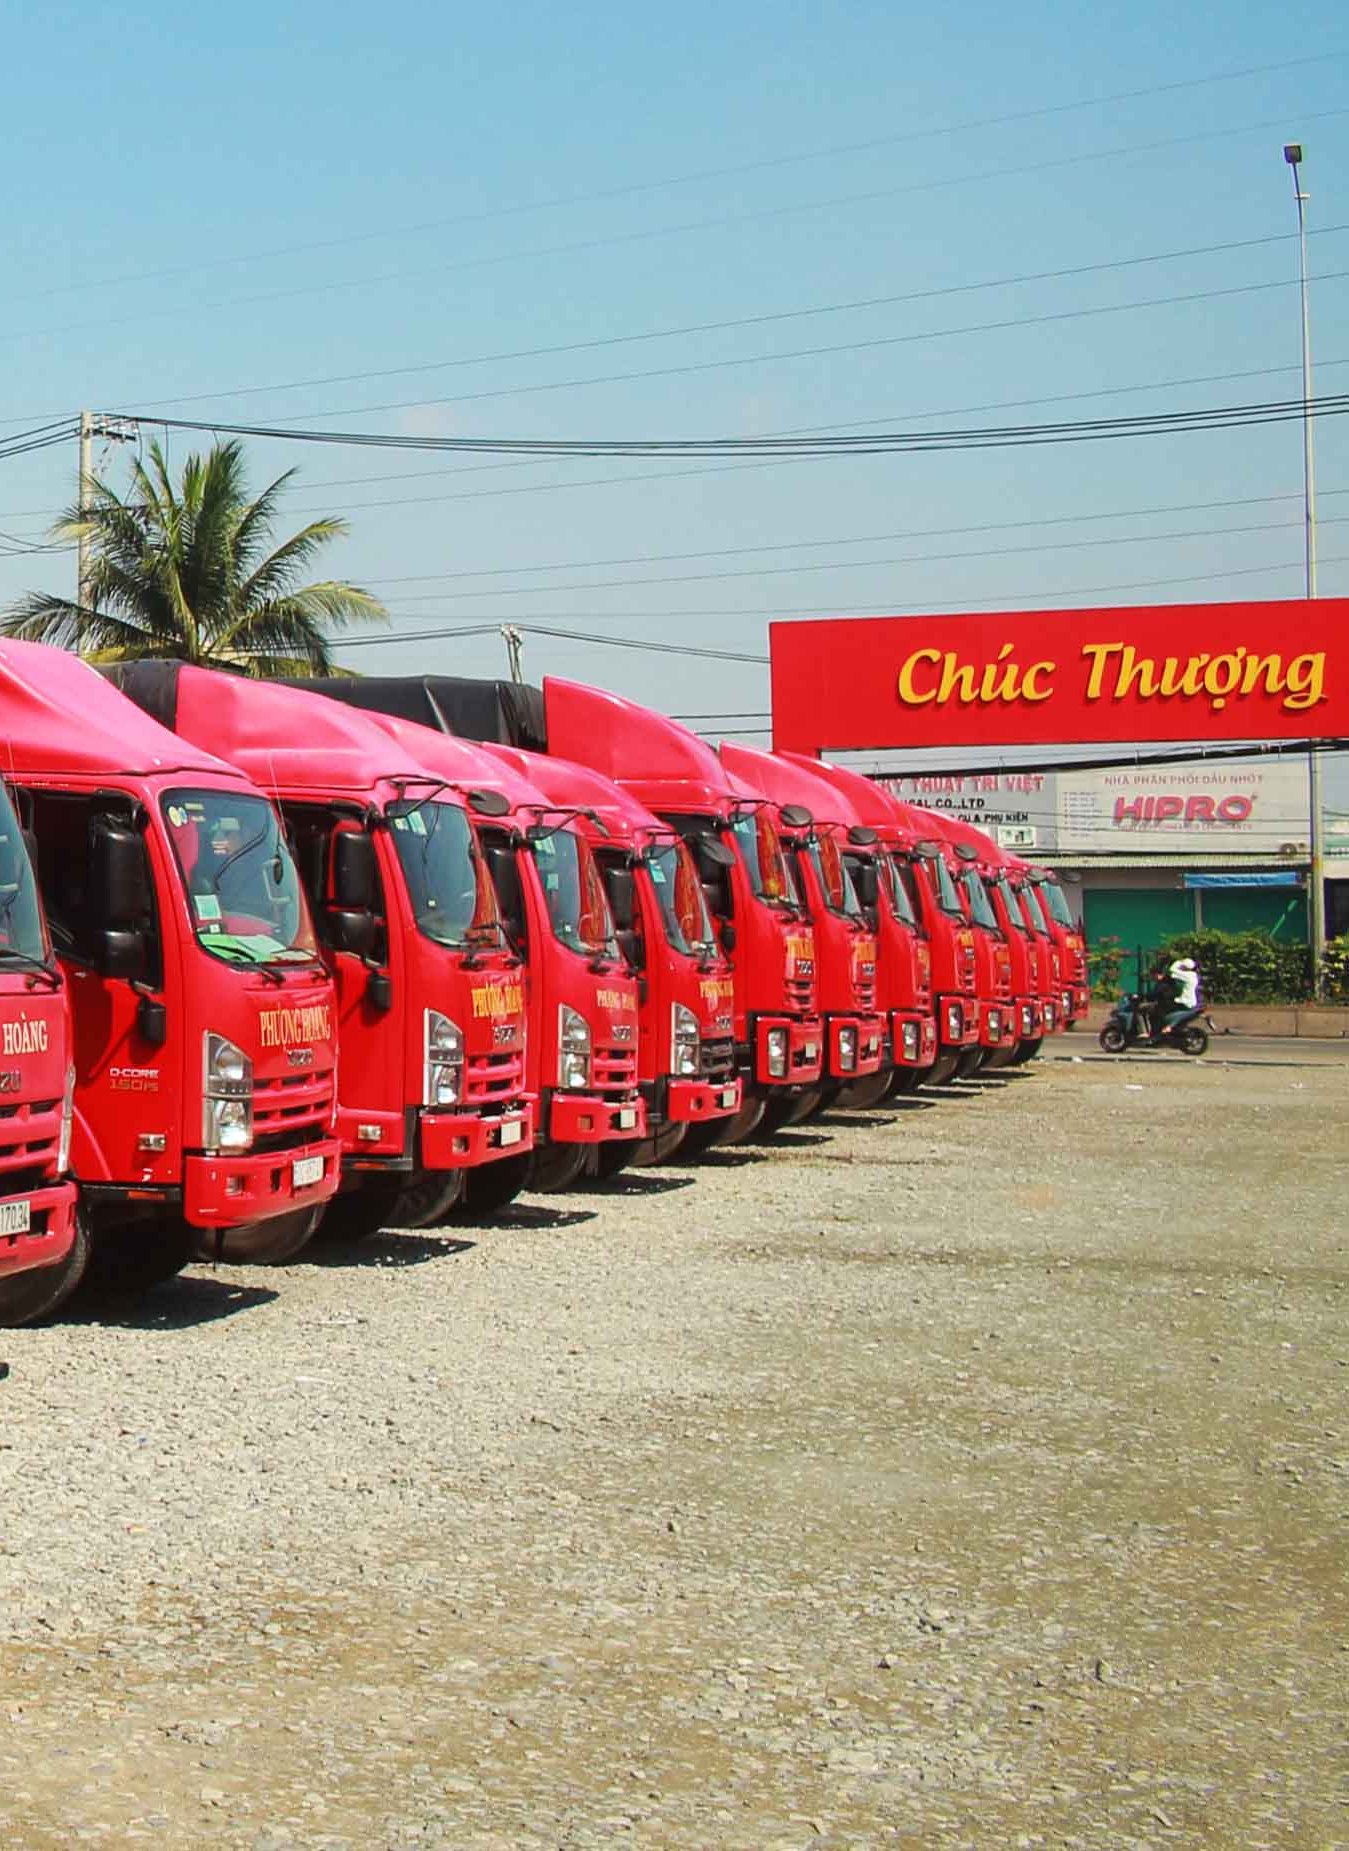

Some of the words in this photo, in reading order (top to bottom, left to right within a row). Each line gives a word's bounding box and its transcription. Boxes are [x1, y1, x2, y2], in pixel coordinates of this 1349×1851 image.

[897, 643, 1056, 705] Chúc
[1081, 642, 1327, 709] Thượng
[1113, 795, 1253, 825] HIPRO
[3, 1011, 48, 1055] HOÀNG
